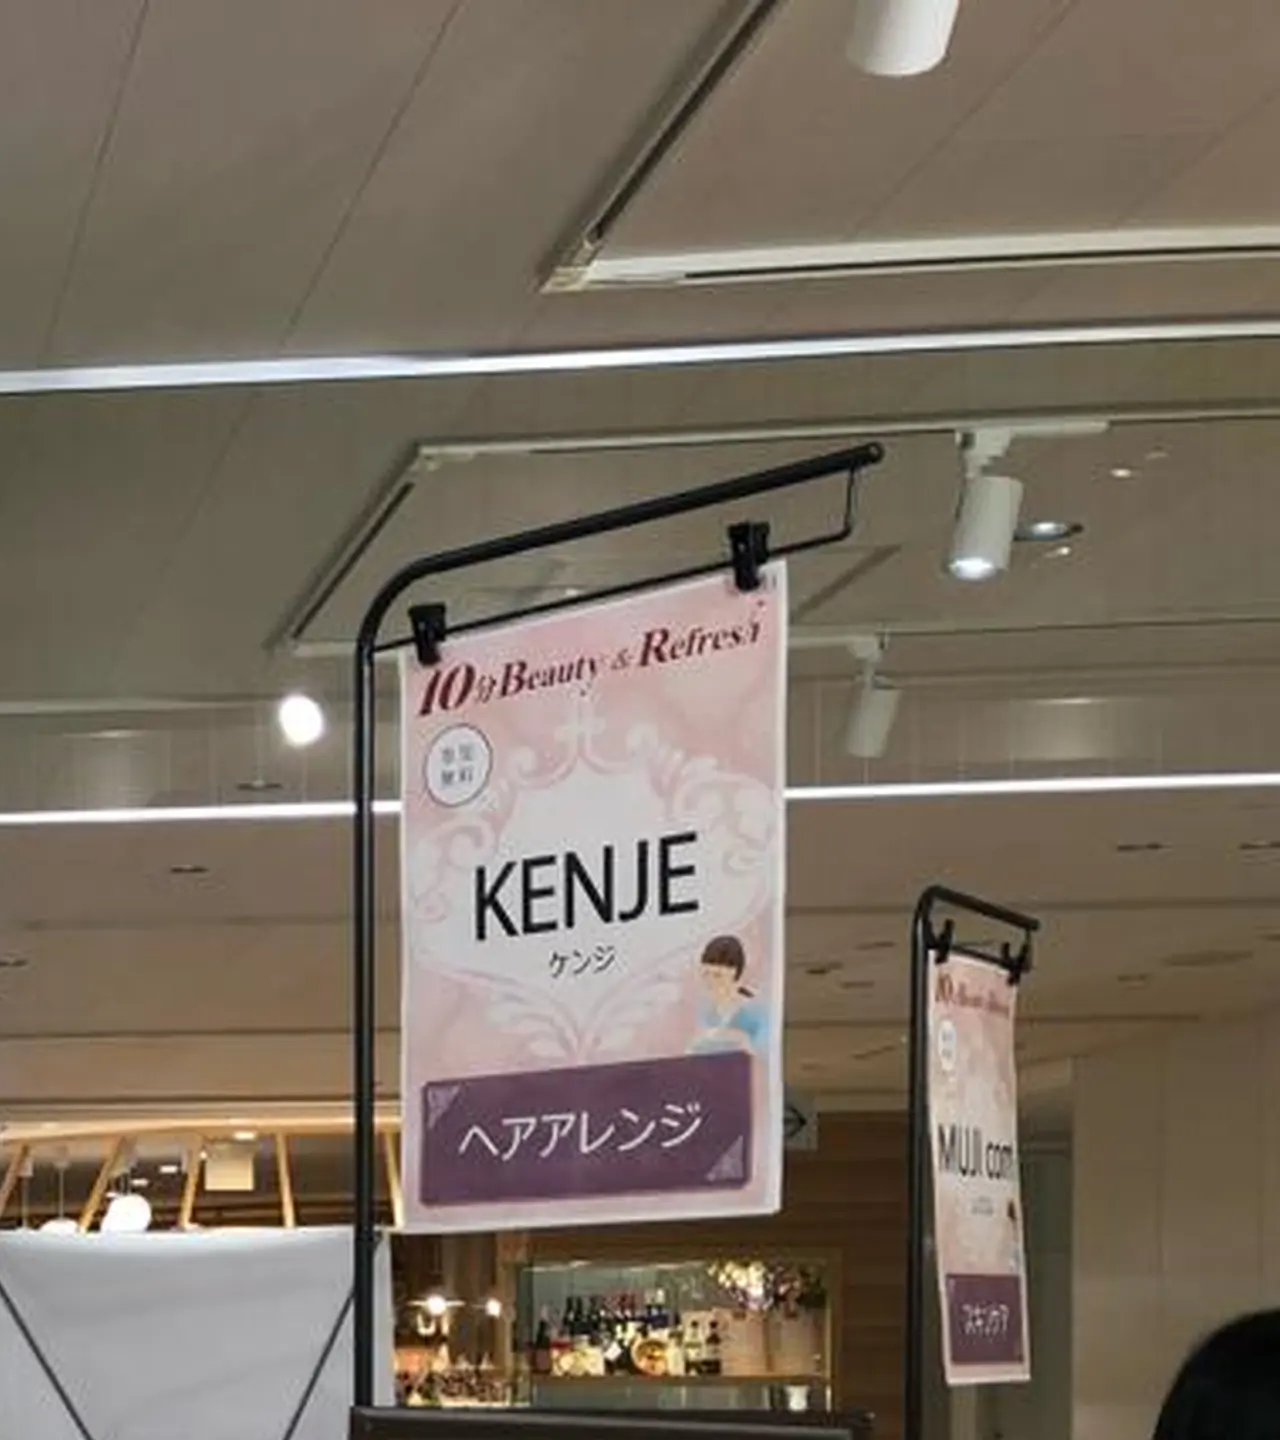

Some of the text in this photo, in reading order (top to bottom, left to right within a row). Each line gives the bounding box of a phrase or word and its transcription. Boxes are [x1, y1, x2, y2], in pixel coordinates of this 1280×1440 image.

[499, 656, 598, 699] Beauty
[611, 649, 633, 671] &
[474, 833, 699, 941] KENJE
[549, 945, 615, 978] ケンジ
[459, 1102, 702, 1162] ヘアアレンジ
[939, 1122, 983, 1177] MUJI
